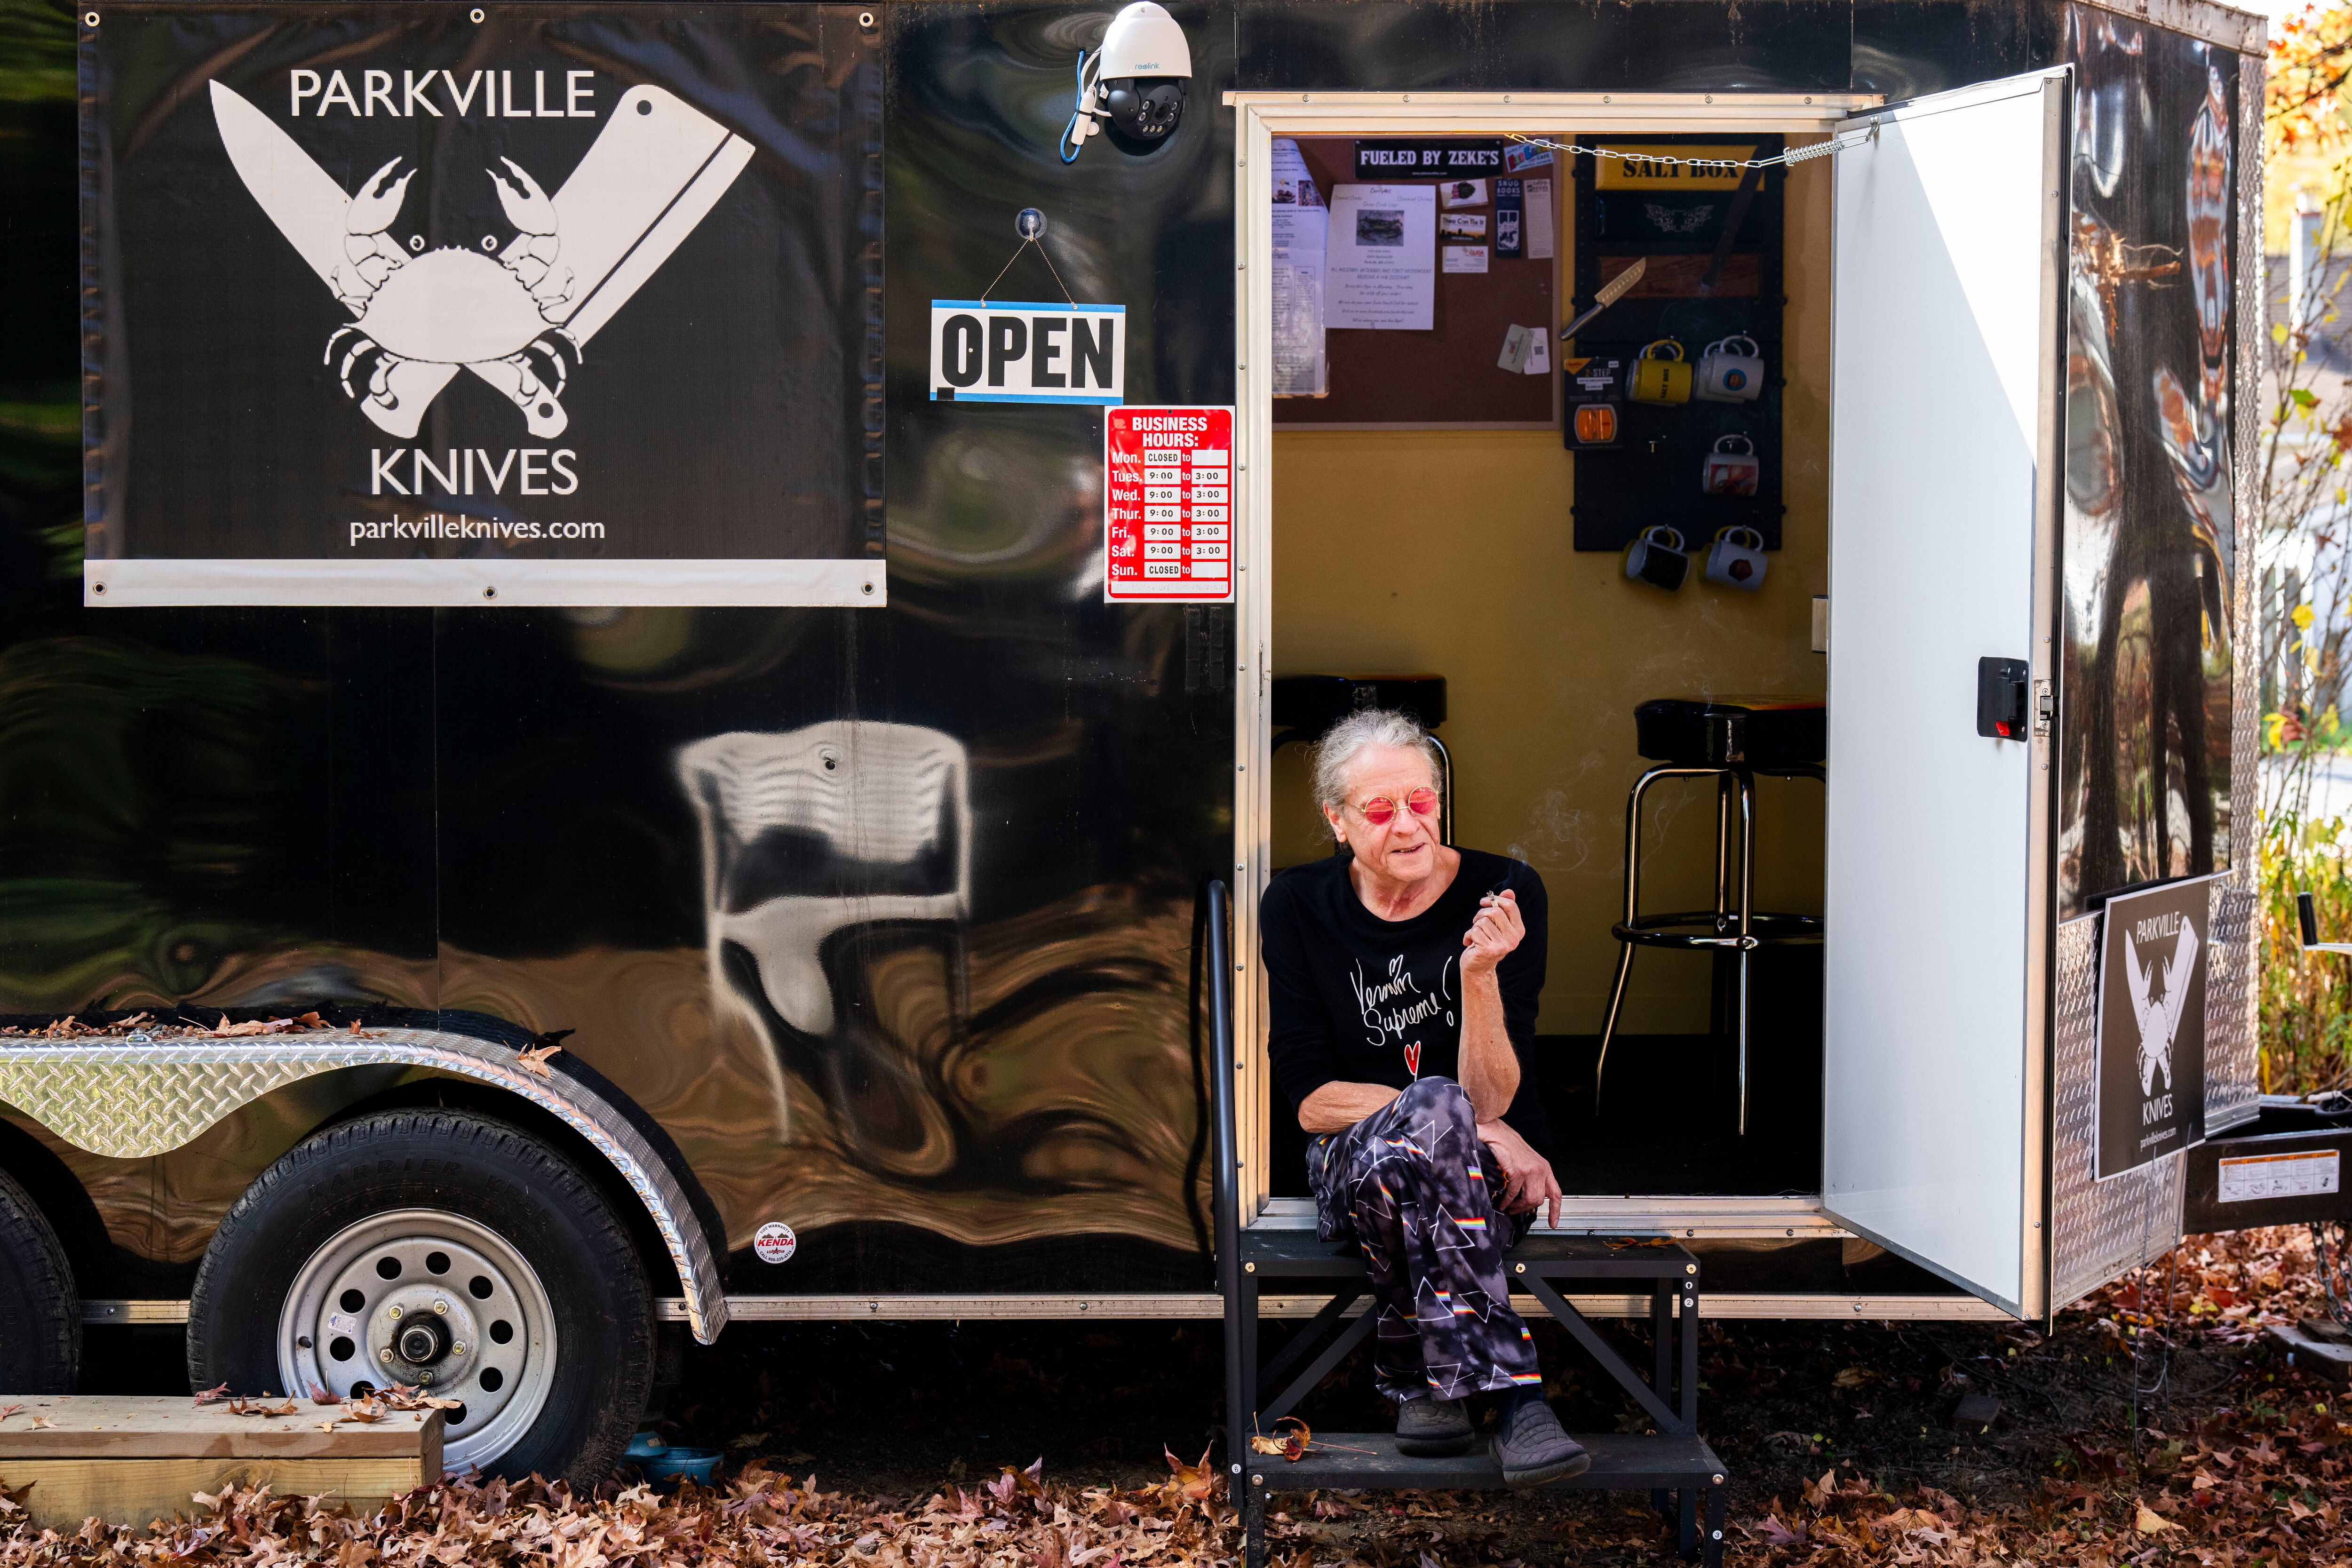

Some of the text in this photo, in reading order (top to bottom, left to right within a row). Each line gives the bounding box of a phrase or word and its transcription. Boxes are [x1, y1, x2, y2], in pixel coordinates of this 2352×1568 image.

[291, 70, 596, 117] PARKVILLE
[1360, 150, 1417, 165] FUELED
[1422, 150, 1442, 165] BY
[1448, 150, 1500, 165] ZEKE'S
[1690, 160, 1739, 178] BOX
[942, 314, 1114, 389] OPEN
[1132, 417, 1208, 431] BUSINESS
[1143, 433, 1199, 447] HOURS:
[1112, 452, 1191, 463] Mon. CLOSED to
[371, 449, 579, 495] KNIVES
[1112, 470, 1142, 482] Tues.
[1182, 472, 1191, 481] to
[1112, 489, 1141, 501] Wed.
[1182, 491, 1191, 500] to
[1112, 508, 1141, 519] Thur.
[1182, 509, 1191, 518] to
[350, 514, 605, 546] parkvilleknives.com
[1112, 527, 1130, 538] Fri.
[1182, 528, 1191, 537] to
[1112, 545, 1134, 557] Sat.
[1182, 547, 1191, 556] to
[1112, 564, 1191, 576] Sun. CLOSED to
[2136, 911, 2180, 945] PARKVILLE
[2143, 1094, 2173, 1126] KNIVES
[2140, 1126, 2177, 1152] parkvilleknives.com
[306, 1157, 556, 1229] KARRIER KR35
[768, 1224, 790, 1234] WARRANTY
[757, 1238, 794, 1247] KENDA
[768, 1250, 792, 1262] 800-225-4714
